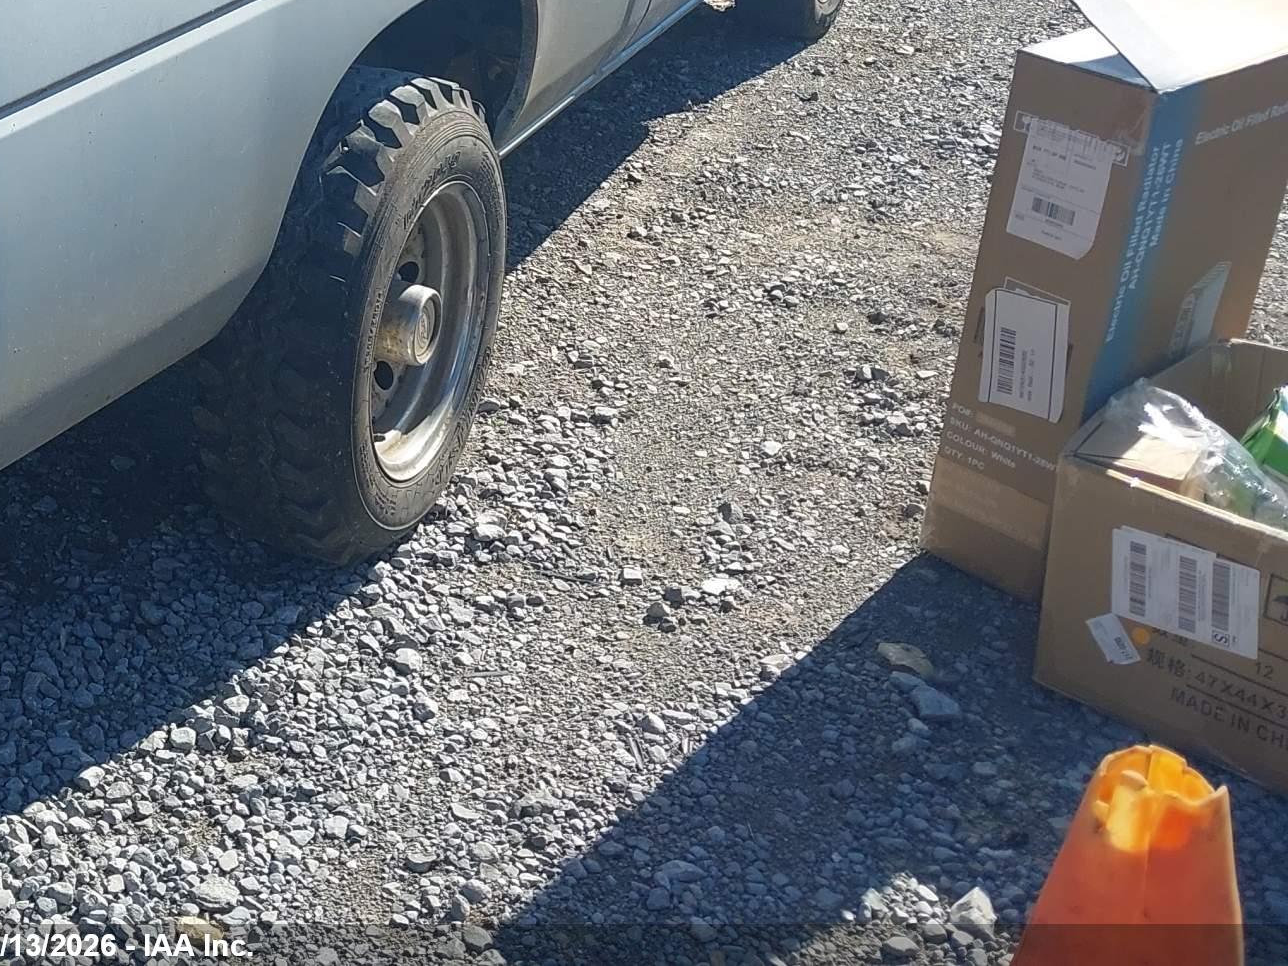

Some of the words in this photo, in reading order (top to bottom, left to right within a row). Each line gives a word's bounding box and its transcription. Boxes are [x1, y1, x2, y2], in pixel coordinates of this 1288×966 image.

[1120, 261, 1133, 283] Oil
[1127, 216, 1144, 258] Filled
[1137, 146, 1160, 212] Radiator
[1149, 206, 1167, 247] Made
[1164, 138, 1184, 184] China
[1171, 687, 1226, 723] MADE
[1231, 714, 1251, 733] IN
[1256, 662, 1274, 681] 12
